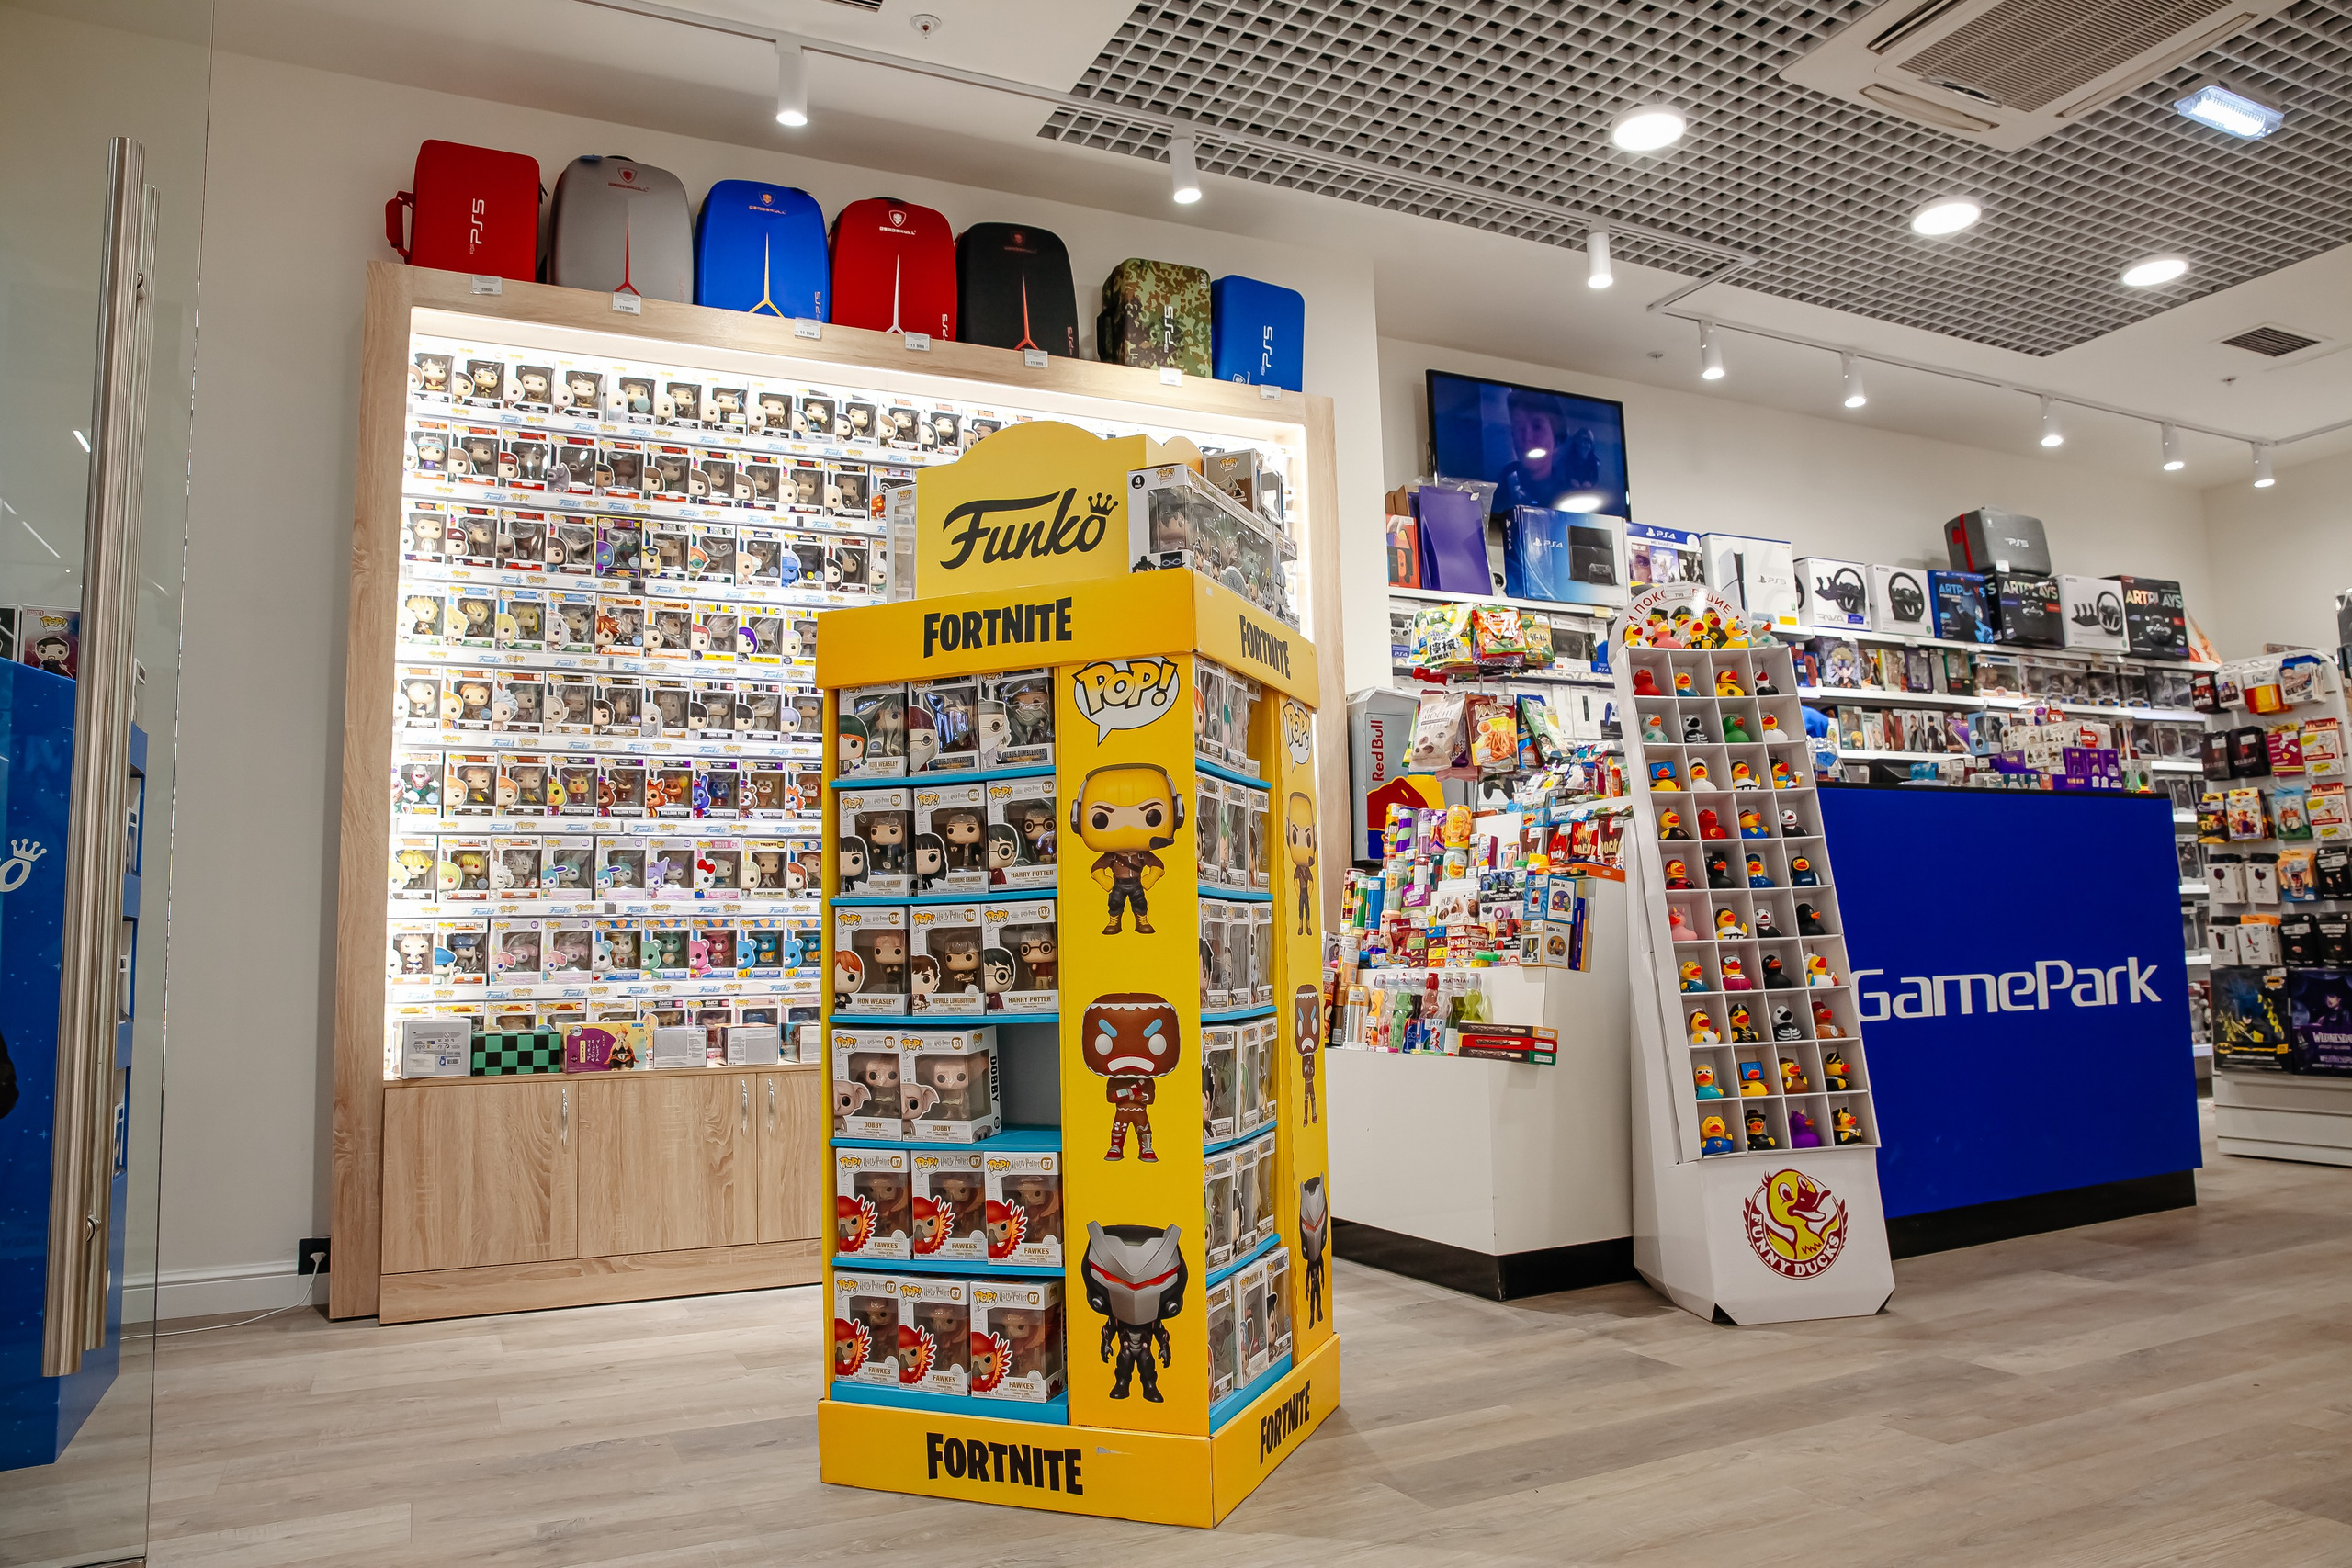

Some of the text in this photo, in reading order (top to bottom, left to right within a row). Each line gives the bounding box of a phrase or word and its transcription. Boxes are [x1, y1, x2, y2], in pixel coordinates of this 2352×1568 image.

[469, 197, 485, 245] PS5
[1200, 273, 1208, 289] BAG
[1164, 305, 1174, 345] PS5
[1067, 326, 1075, 352] PS5
[1262, 325, 1273, 367] PS5
[500, 415, 521, 424] Funko
[699, 436, 720, 445] Funko
[1219, 457, 1238, 469] POP!
[1156, 468, 1175, 480] POP!
[1135, 476, 1142, 485] 4
[484, 491, 506, 501] Funko
[812, 520, 832, 529] Funko
[940, 487, 1108, 570] Funko
[1656, 530, 1677, 540] PS4
[1543, 540, 1564, 548] PS4
[1767, 576, 1787, 585] PS5
[654, 586, 675, 594] Funko
[40, 616, 68, 628] POP!
[923, 597, 1073, 660] FORTNITE
[1238, 614, 1292, 681] FORTNITE
[554, 659, 576, 667] Funko
[1071, 660, 1179, 717] POP!
[1283, 698, 1311, 751] POP!
[492, 739, 514, 747] Funko
[1370, 720, 1385, 782] Red Bull
[989, 786, 1013, 799] POP!
[1042, 783, 1054, 791] 132
[891, 796, 901, 806] 150
[917, 795, 941, 807] POP!
[968, 791, 978, 800] 150
[842, 797, 864, 810] POP!
[633, 825, 655, 833] Funko
[1030, 869, 1054, 877] POTTER
[471, 908, 495, 916] Funko
[912, 912, 935, 925] POP!
[965, 911, 976, 919] 116
[984, 909, 1009, 923] POP!
[1039, 908, 1049, 917] 132
[838, 914, 862, 927] POP!
[889, 914, 899, 923] 134
[769, 984, 791, 992] Funko
[1850, 956, 2163, 1022] GamePark
[870, 998, 896, 1006] WEASLEY
[1027, 995, 1052, 1003] POTTER
[834, 1035, 857, 1049] POP!
[885, 1039, 895, 1047] 151
[900, 1037, 923, 1051] POP!
[952, 1039, 962, 1048] 151
[990, 1055, 999, 1103] DOBBY
[839, 1156, 862, 1169] POP!
[891, 1157, 901, 1166] 87
[914, 1156, 937, 1169] POP!
[987, 1159, 1010, 1172] POP!
[1041, 1159, 1052, 1168] 87
[1751, 1213, 1840, 1276] FUNNY DUCKS
[837, 1280, 858, 1292] POP!
[899, 1285, 922, 1299] POP!
[974, 1290, 997, 1303] POP!
[1028, 1293, 1039, 1302] 87
[868, 1367, 891, 1375] FAWKES
[933, 1374, 956, 1383] FAWKES
[1008, 1382, 1035, 1390] FAWKES
[1259, 1379, 1311, 1468] FORTNITE
[926, 1431, 1083, 1496] FORTNITE
